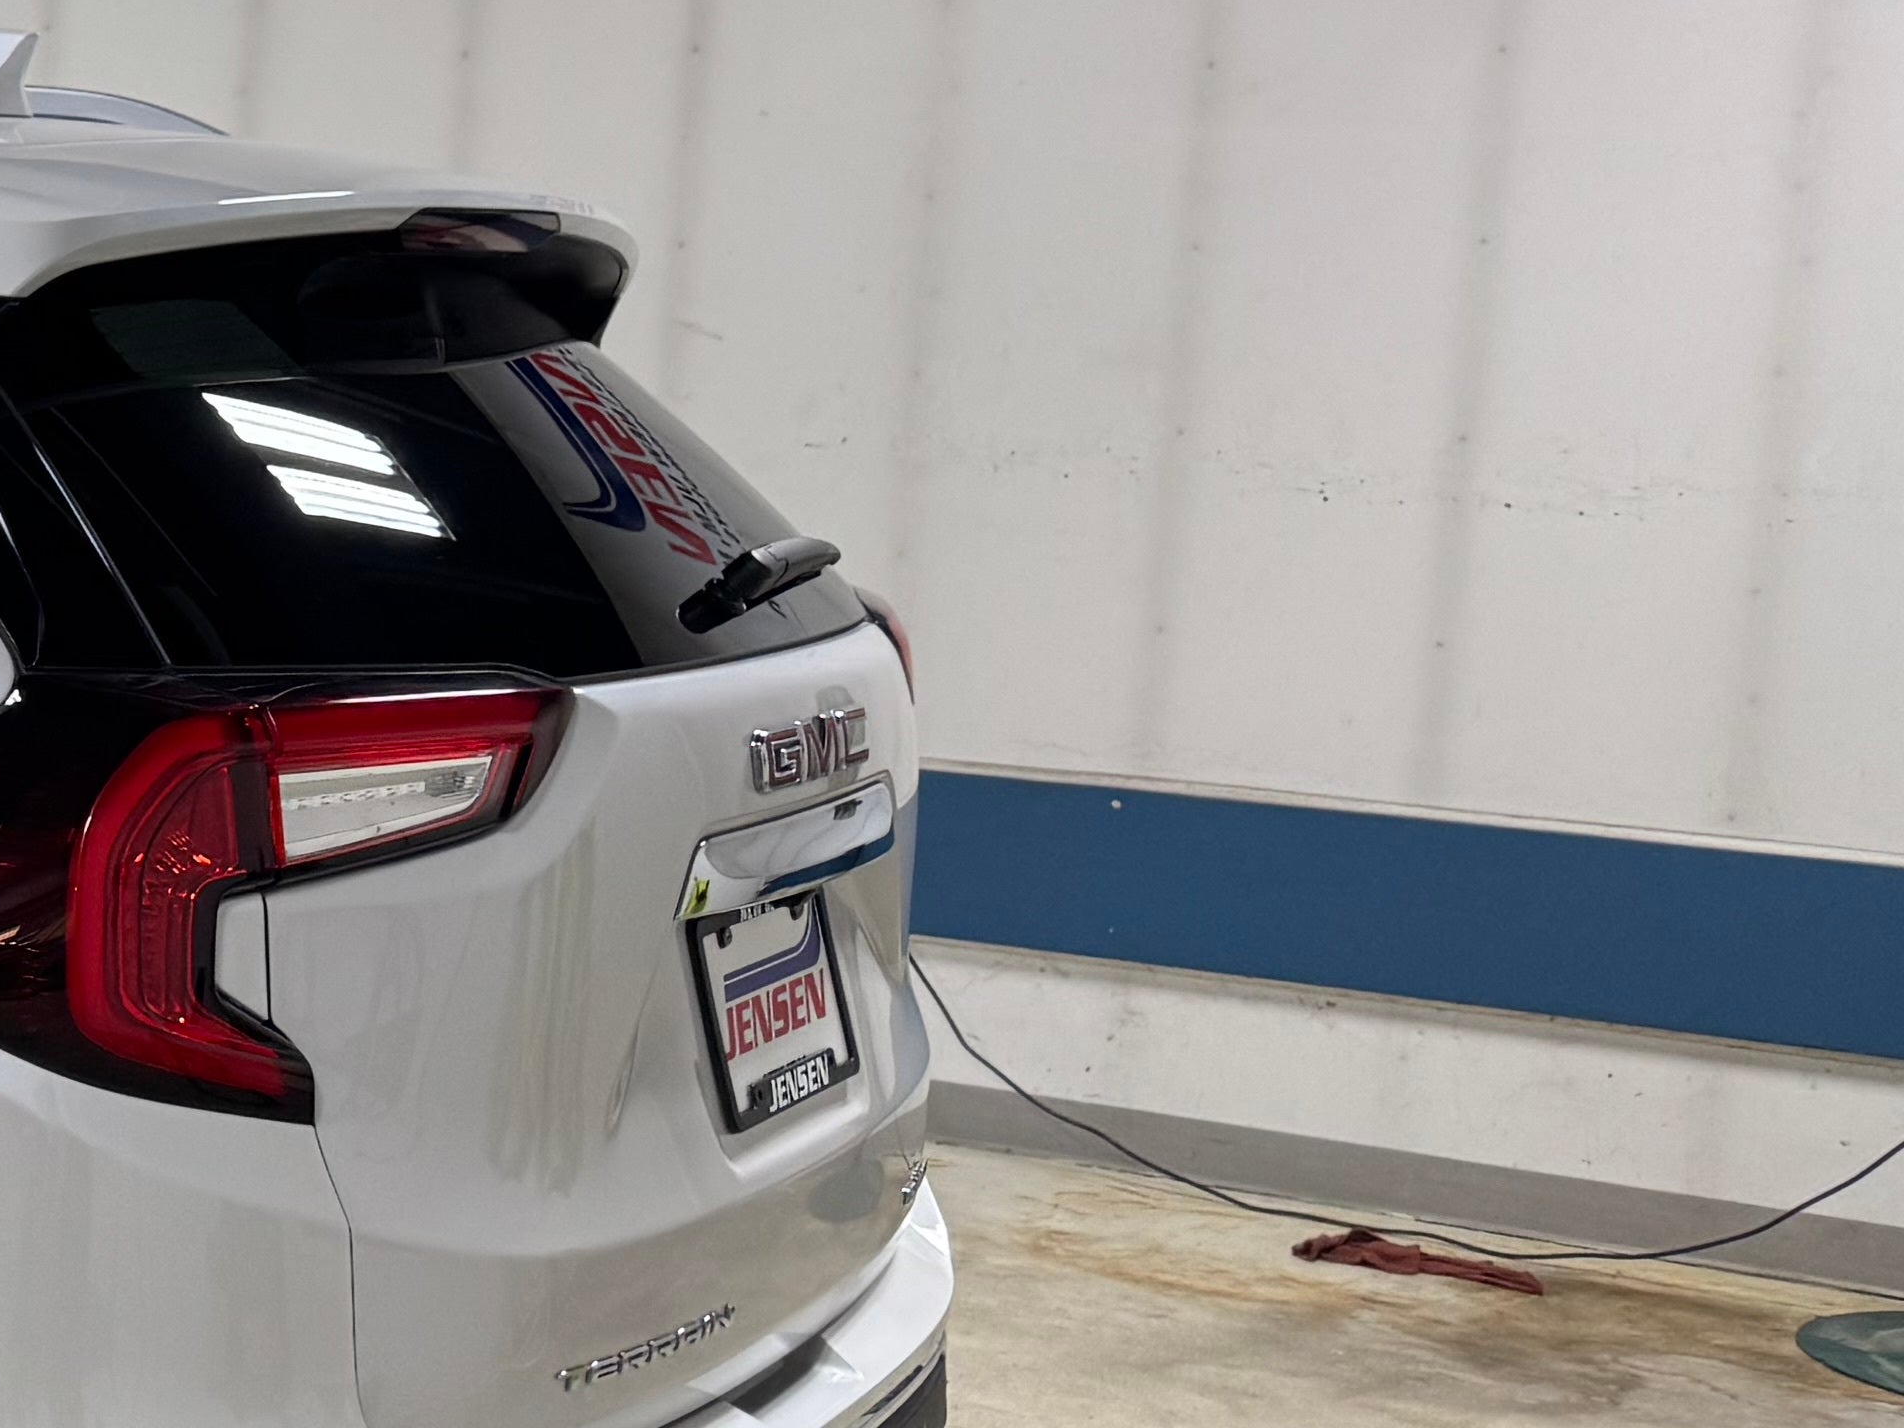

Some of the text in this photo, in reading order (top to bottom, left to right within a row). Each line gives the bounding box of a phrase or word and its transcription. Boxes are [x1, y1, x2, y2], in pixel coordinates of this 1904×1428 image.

[749, 707, 870, 795] GMC
[724, 967, 828, 1062] JENSEN
[769, 1053, 830, 1113] JENSEN
[554, 1302, 736, 1392] TERRAIN
